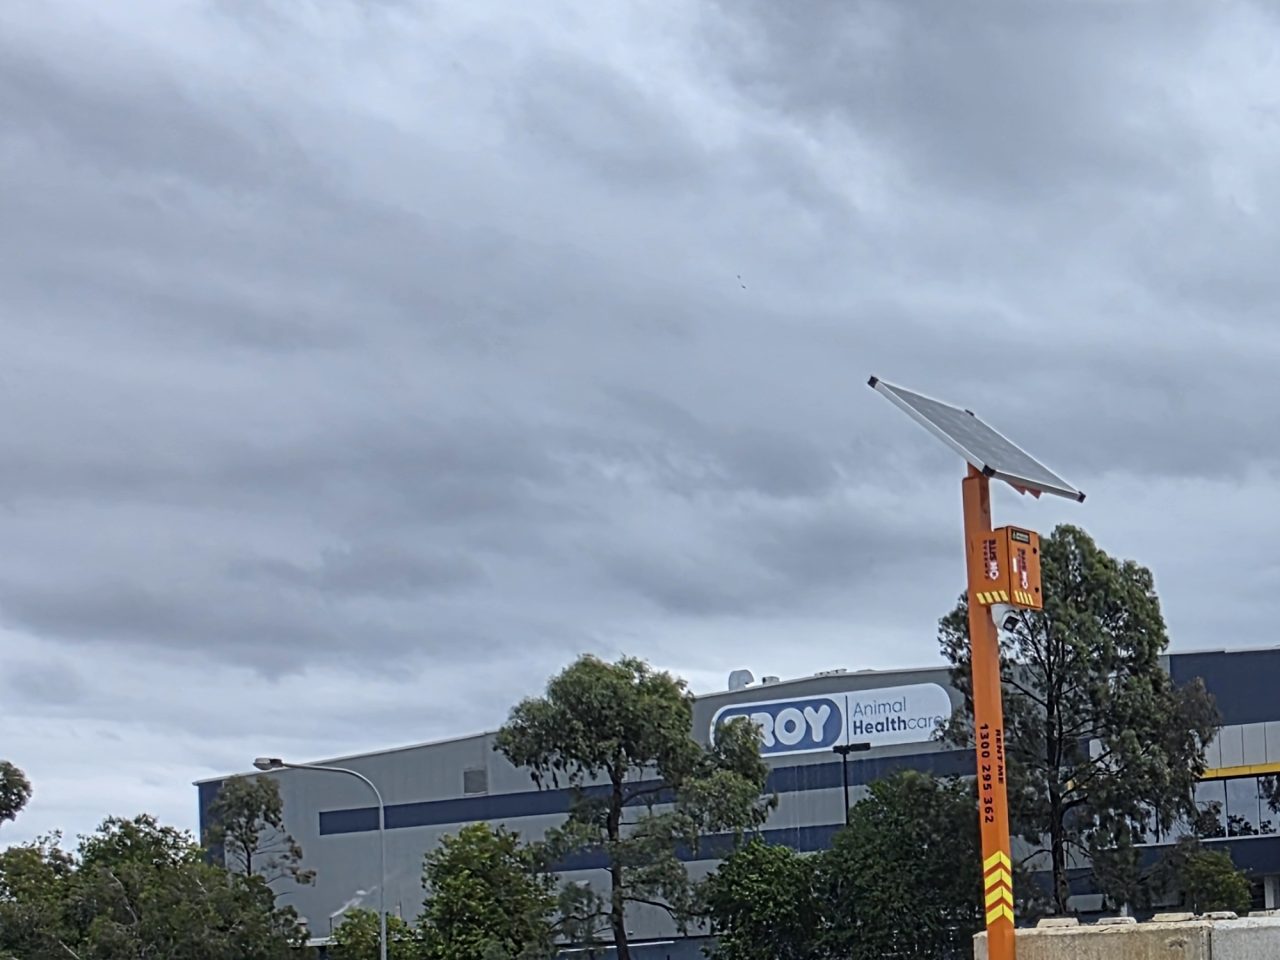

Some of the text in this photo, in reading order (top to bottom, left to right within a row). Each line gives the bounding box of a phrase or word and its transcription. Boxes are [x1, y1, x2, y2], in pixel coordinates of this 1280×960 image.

[853, 696, 907, 717] Animal
[853, 715, 943, 736] Healthcare
[980, 723, 994, 824] 1300 295 362
[997, 765, 1004, 784] ME
